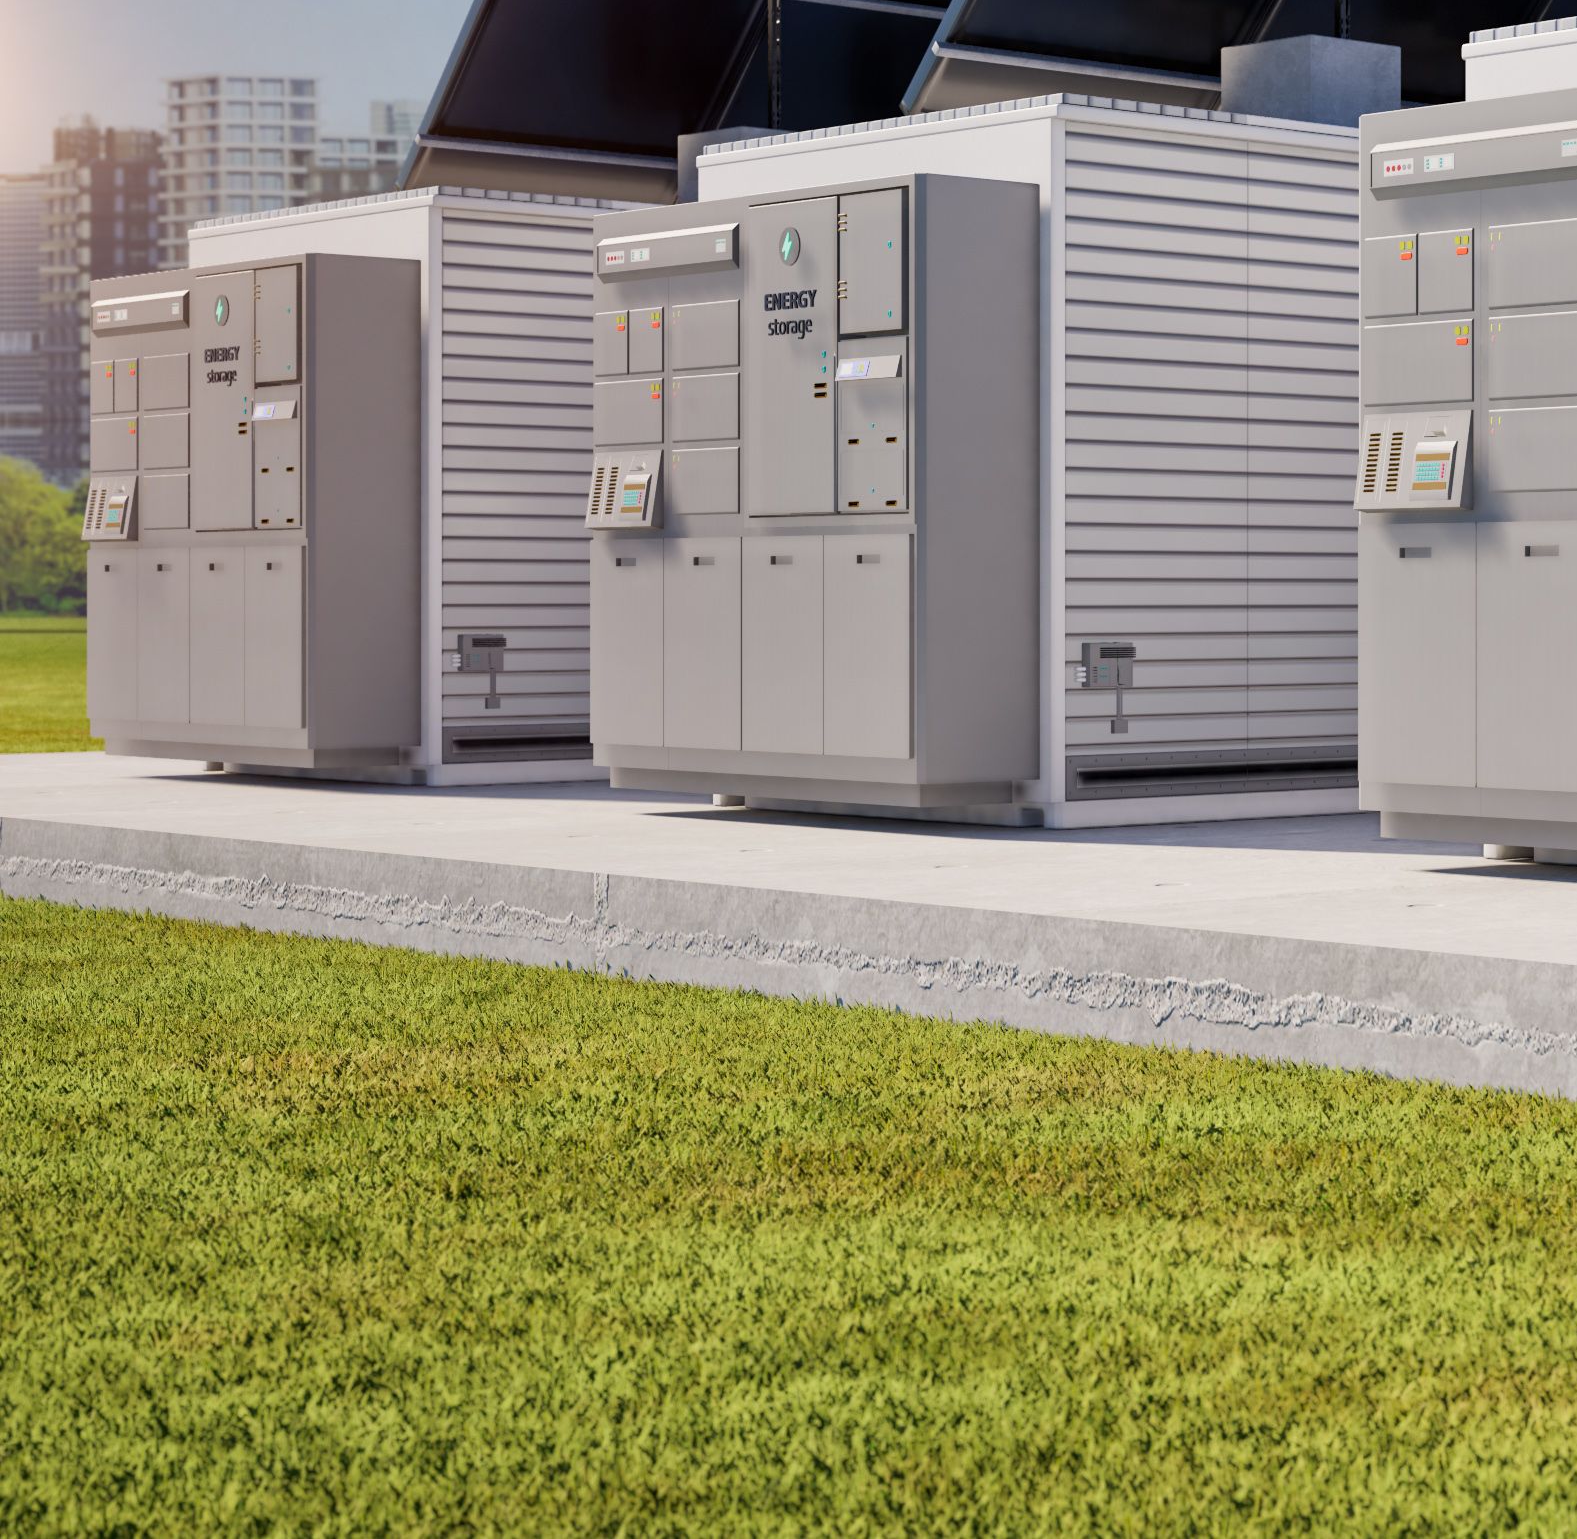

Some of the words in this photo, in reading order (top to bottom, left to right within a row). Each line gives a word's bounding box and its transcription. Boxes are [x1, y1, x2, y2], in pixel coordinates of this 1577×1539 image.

[764, 289, 818, 312] ENERGY
[767, 317, 813, 340] storage
[204, 346, 240, 363] ENERGY
[206, 369, 238, 387] storage
